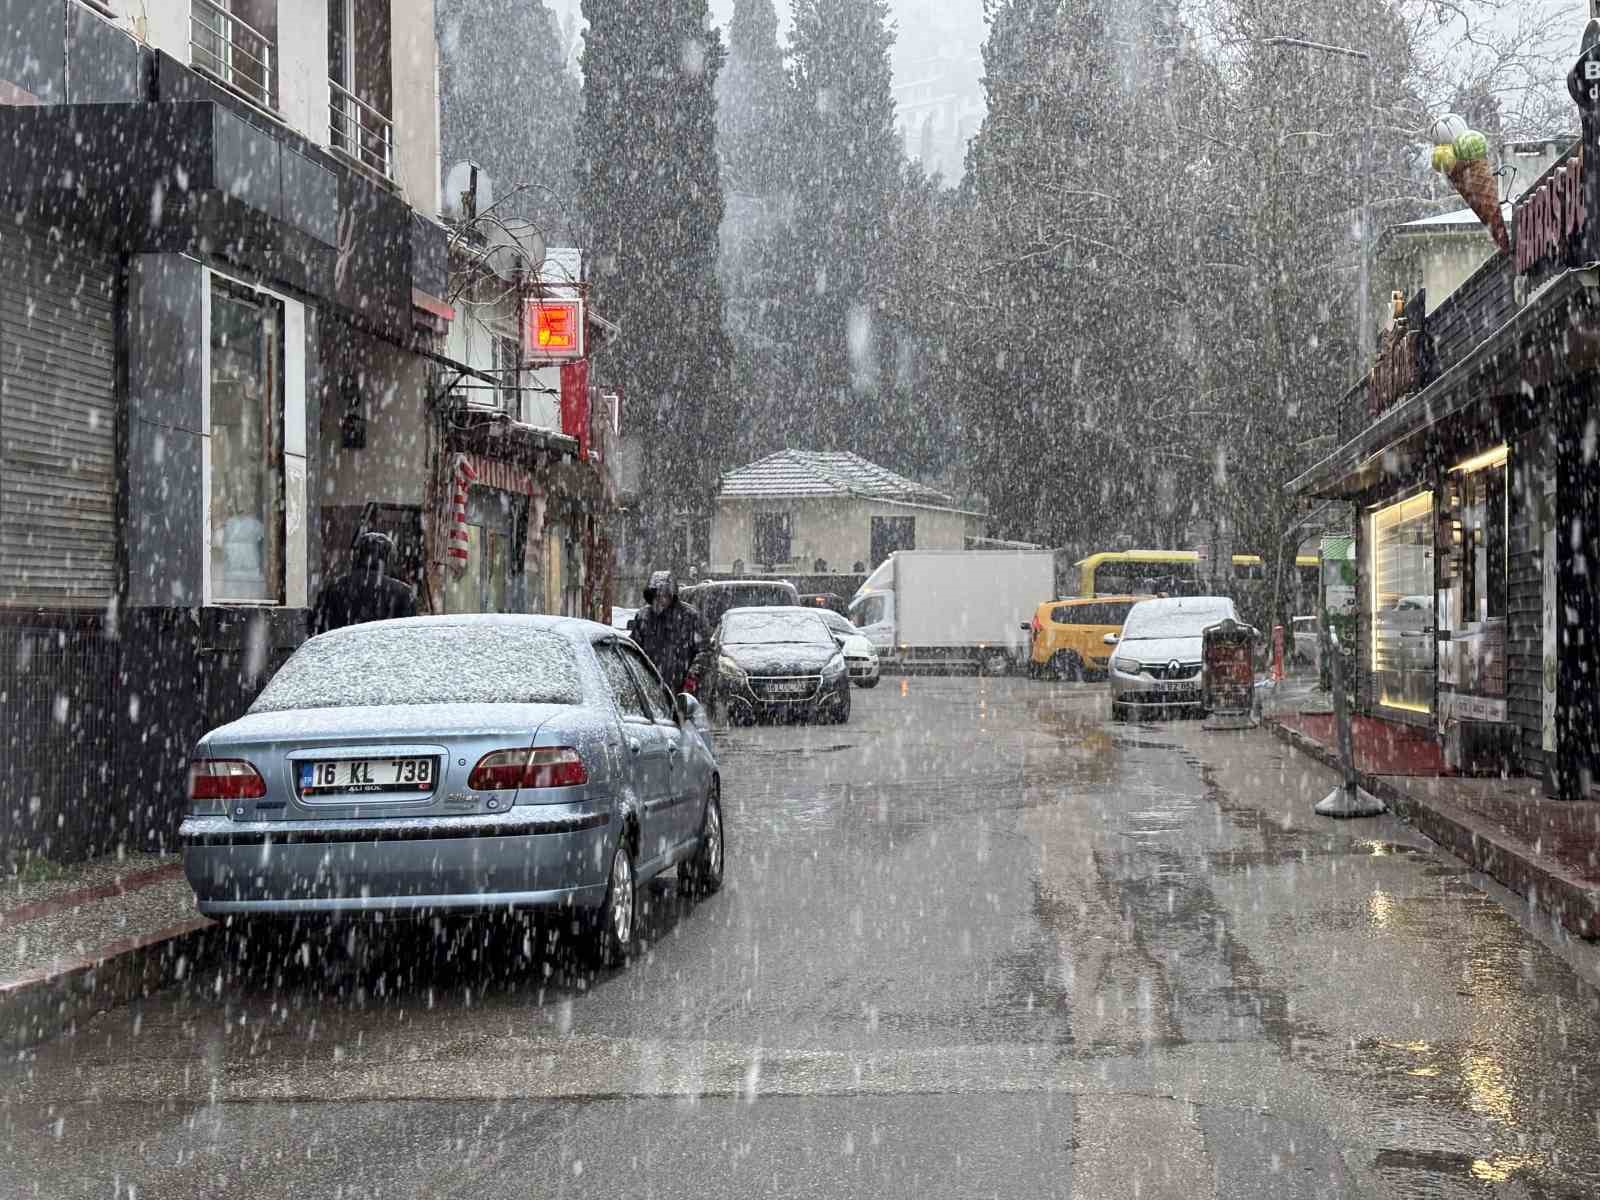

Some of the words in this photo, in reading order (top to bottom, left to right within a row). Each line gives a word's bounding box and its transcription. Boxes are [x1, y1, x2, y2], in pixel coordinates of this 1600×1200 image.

[1585, 61, 1600, 79] B
[1589, 83, 1600, 99] d
[316, 764, 336, 785] 16
[350, 762, 374, 783] KL
[392, 760, 429, 782] 738
